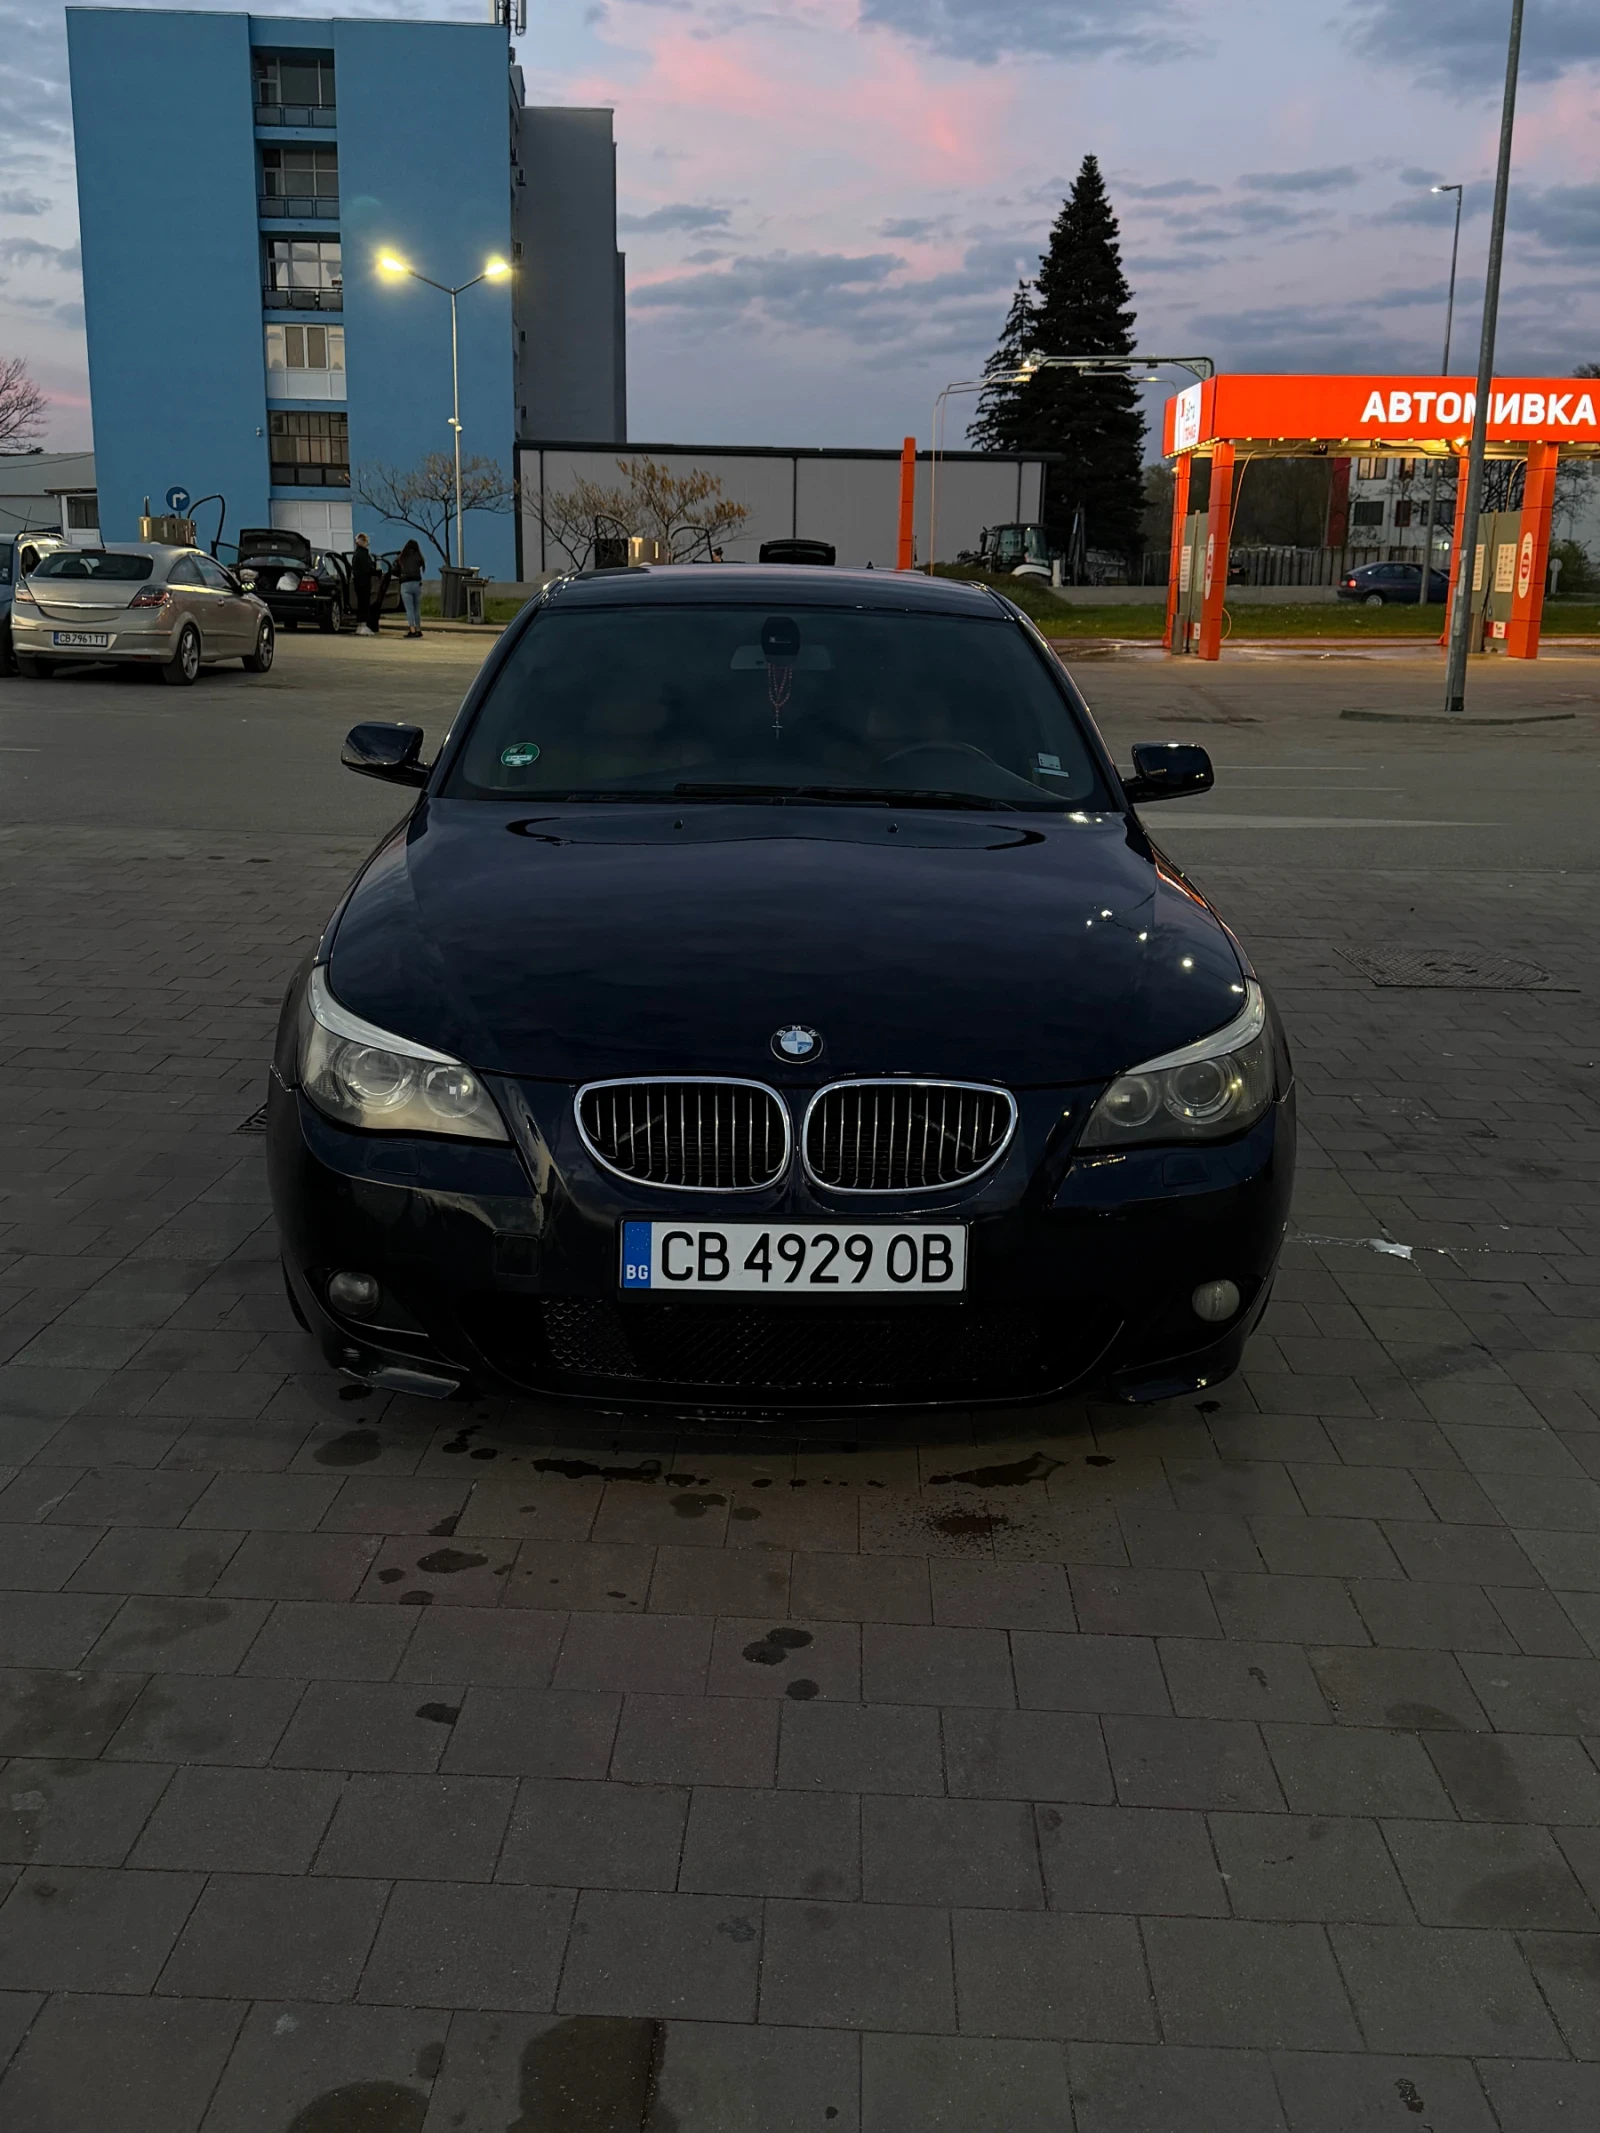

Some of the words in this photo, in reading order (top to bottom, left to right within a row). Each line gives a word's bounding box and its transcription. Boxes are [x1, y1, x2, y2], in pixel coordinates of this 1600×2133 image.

[1360, 391, 1597, 426] АВТОМИВКА
[60, 633, 71, 643] CB
[72, 634, 92, 644] 7961
[95, 635, 105, 644] TT
[776, 1024, 820, 1037] BMW
[661, 1230, 730, 1282] CB
[743, 1232, 873, 1284] 4929
[886, 1233, 954, 1284] OB
[626, 1264, 649, 1280] BG
